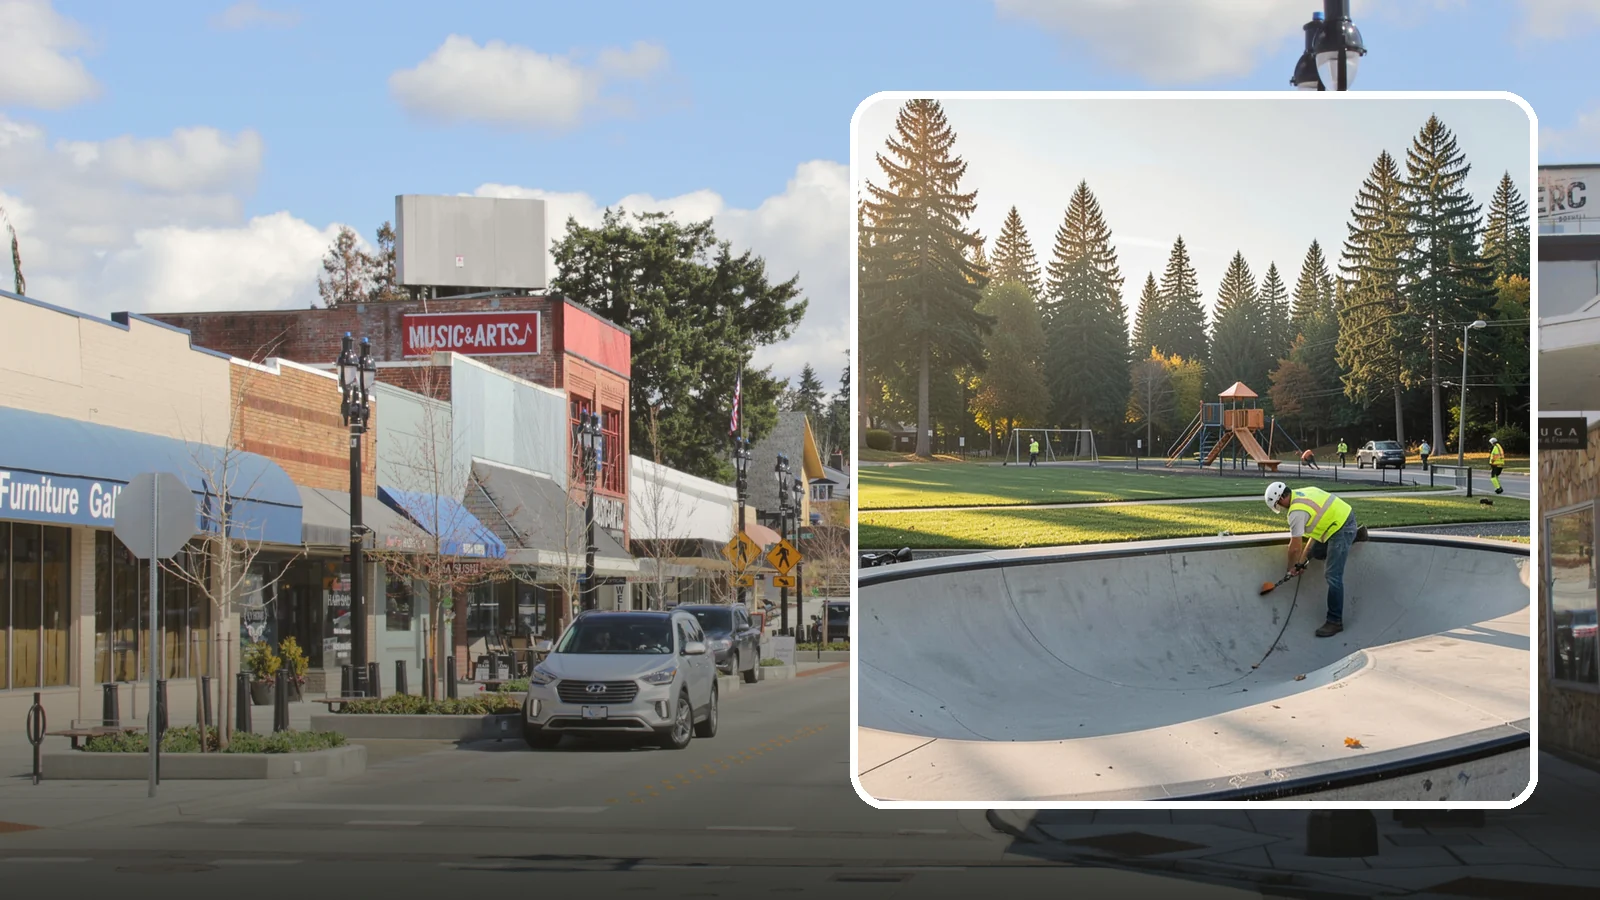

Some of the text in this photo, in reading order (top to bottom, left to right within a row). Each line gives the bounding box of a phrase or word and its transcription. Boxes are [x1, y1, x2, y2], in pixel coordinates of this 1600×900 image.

[0, 471, 122, 519] Furniture Gal
[453, 563, 479, 575] SUSHI
